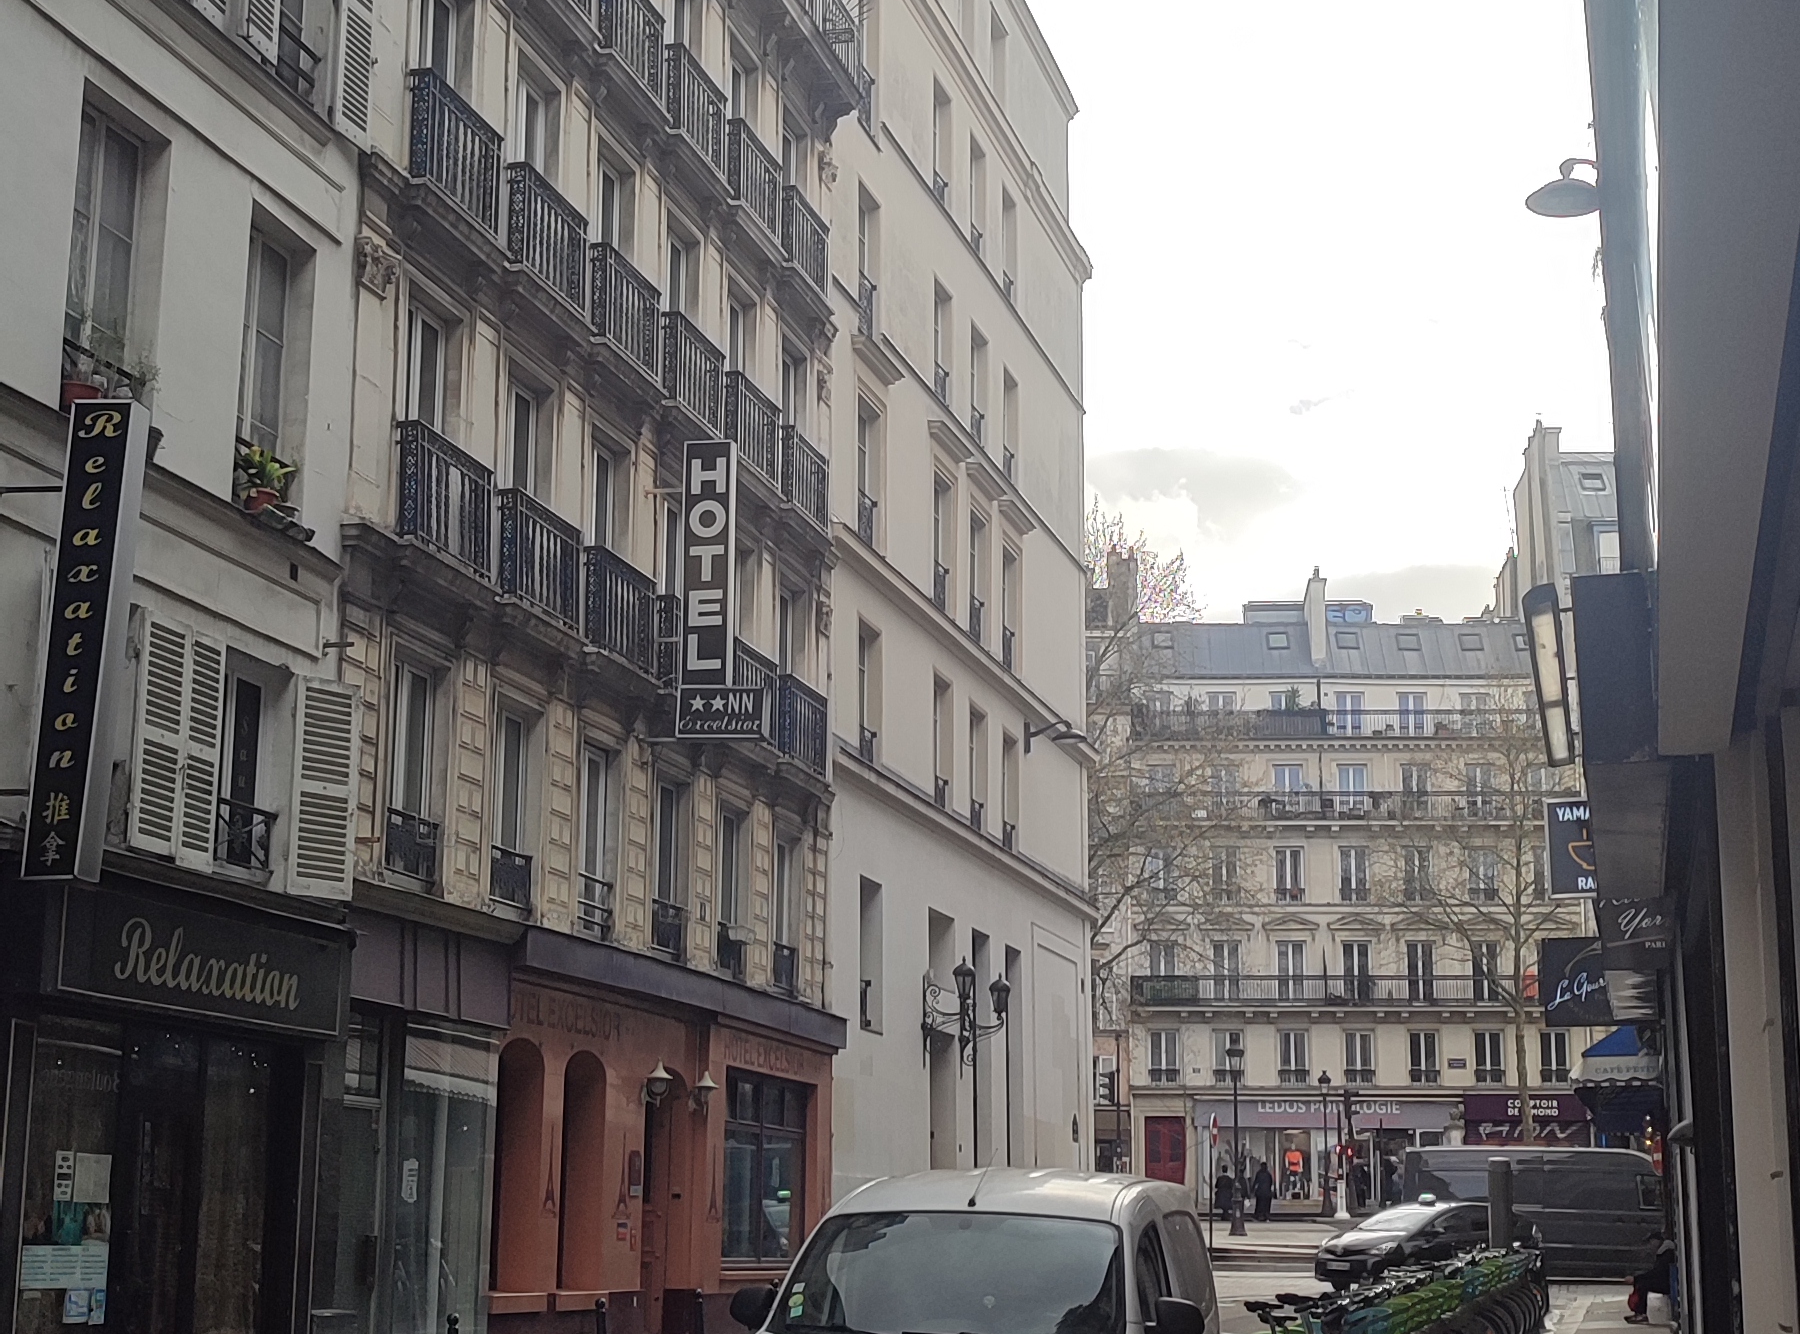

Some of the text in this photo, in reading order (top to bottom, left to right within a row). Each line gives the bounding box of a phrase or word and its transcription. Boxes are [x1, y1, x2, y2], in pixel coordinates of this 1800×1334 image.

[686, 456, 728, 672] HOTEL
[48, 409, 123, 771] Relaxation
[679, 713, 762, 733] Excelsior
[1577, 876, 1598, 891] RA
[114, 917, 301, 1011] Relaxation
[546, 997, 622, 1043] EXCELSIOR
[723, 1031, 755, 1067] HOTEL
[1257, 1100, 1401, 1114] LEDOS PODLOGIE
[1507, 1099, 1558, 1108] COPTOIR
